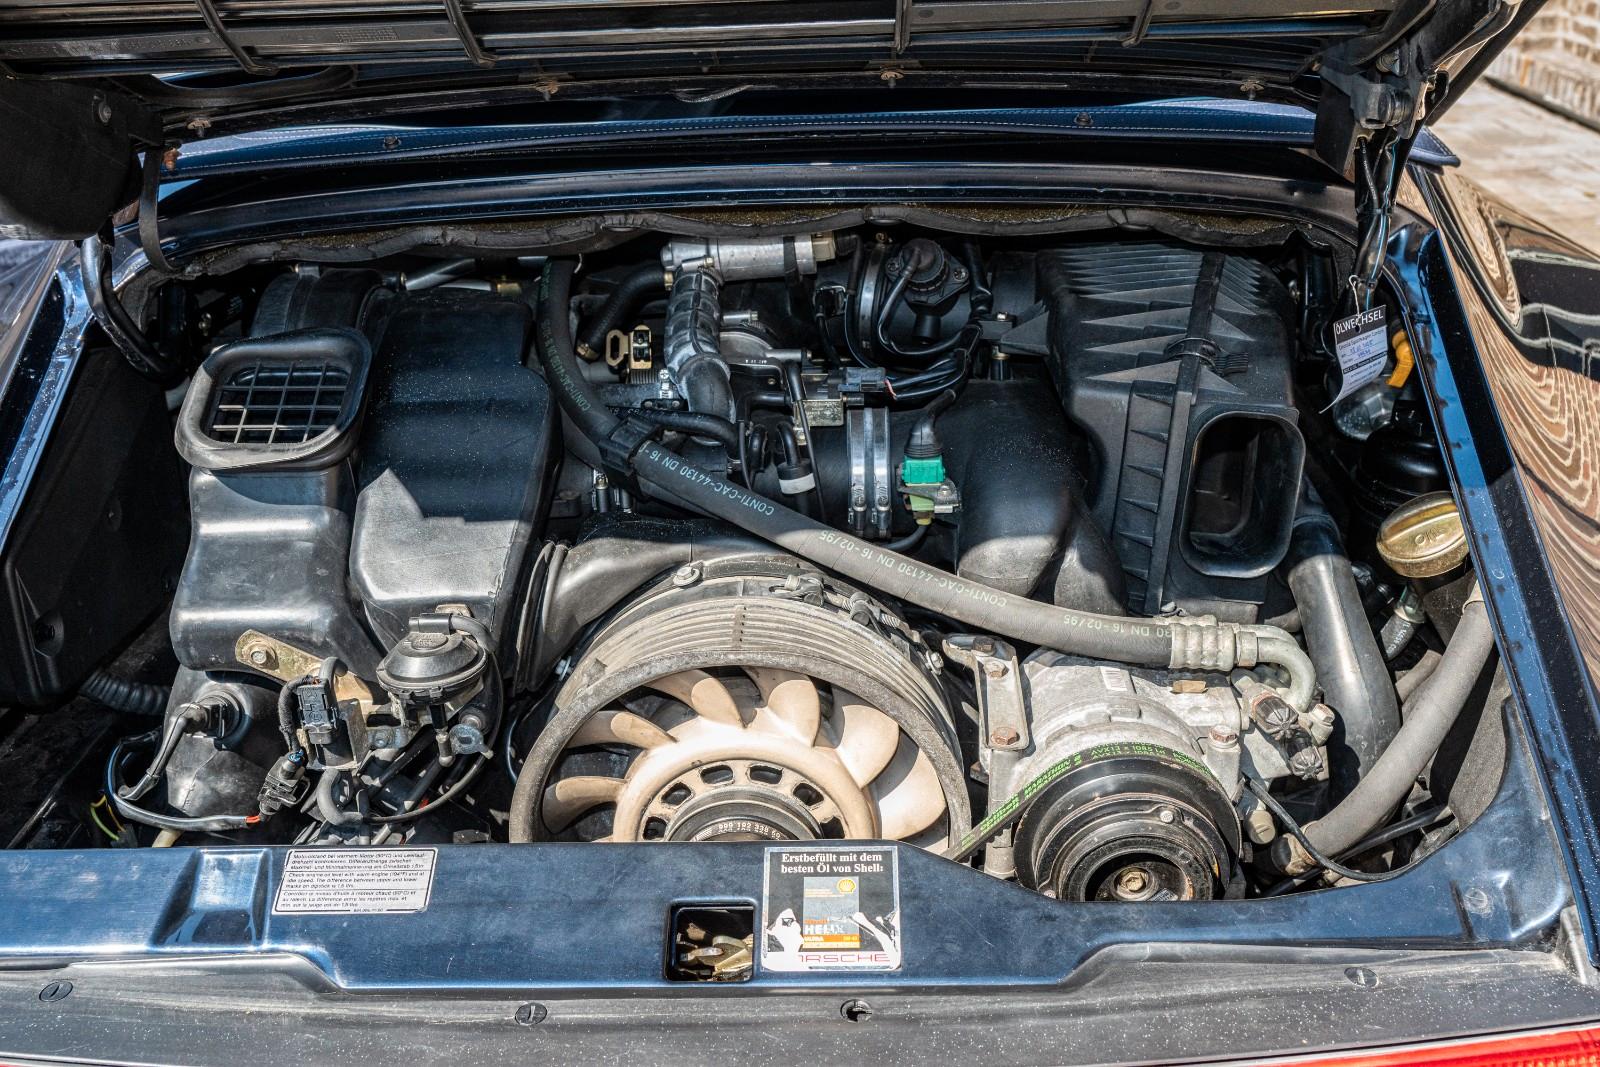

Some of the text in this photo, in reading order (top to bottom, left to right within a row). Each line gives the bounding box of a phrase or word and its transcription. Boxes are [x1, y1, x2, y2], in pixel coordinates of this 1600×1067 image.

[1336, 310, 1383, 334] ÖLWECHSEL
[661, 456, 680, 470] DN
[680, 466, 775, 516] CONTI-CAC-44130
[876, 554, 896, 568] DN
[899, 563, 1008, 608] CONTI-CAC-44130
[1130, 625, 1150, 636] DN
[782, 853, 882, 862] Erstbefüllt mit dem
[781, 864, 813, 873] besten
[816, 863, 829, 873] Öl
[854, 864, 884, 872] Shell:
[804, 924, 845, 934] HELIX
